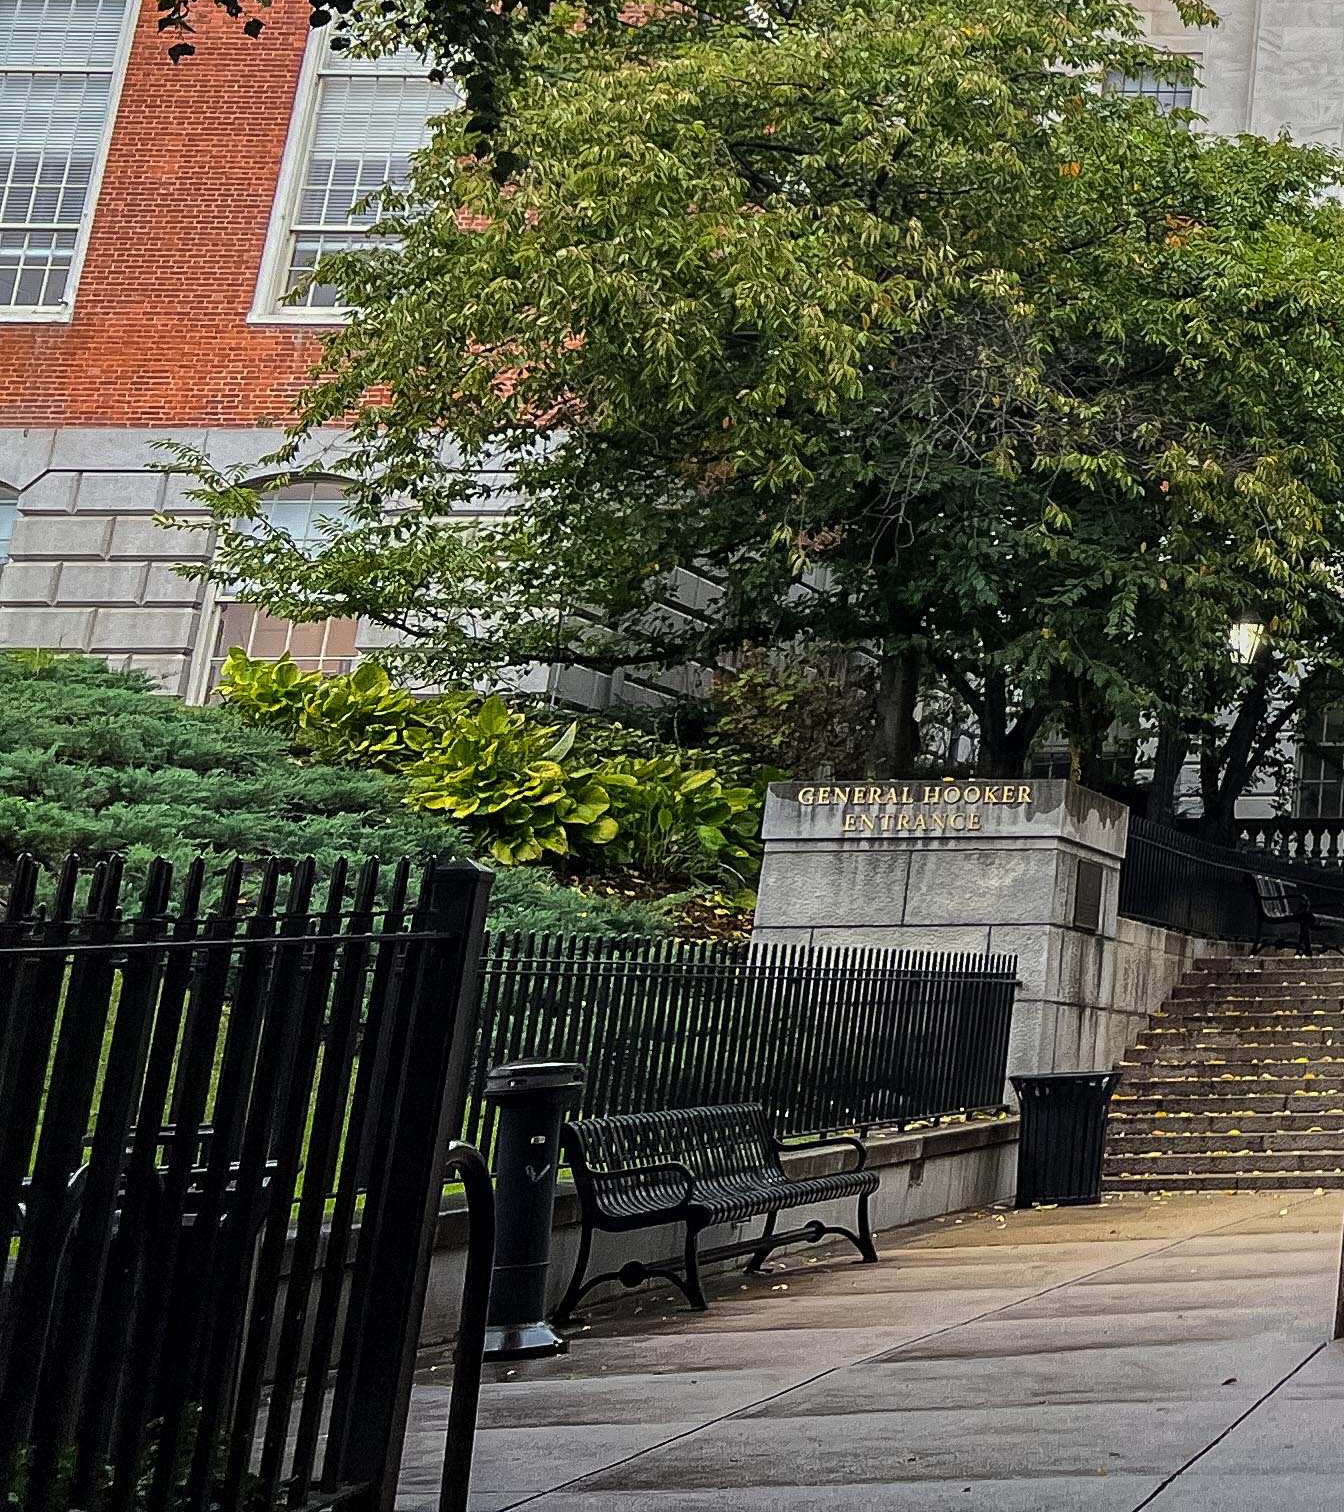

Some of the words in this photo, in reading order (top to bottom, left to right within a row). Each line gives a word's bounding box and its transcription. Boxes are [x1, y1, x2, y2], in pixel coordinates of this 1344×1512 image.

[798, 786, 914, 805] GENERAL
[923, 786, 1032, 805] HOOKER
[842, 813, 982, 832] ENTRANCE
